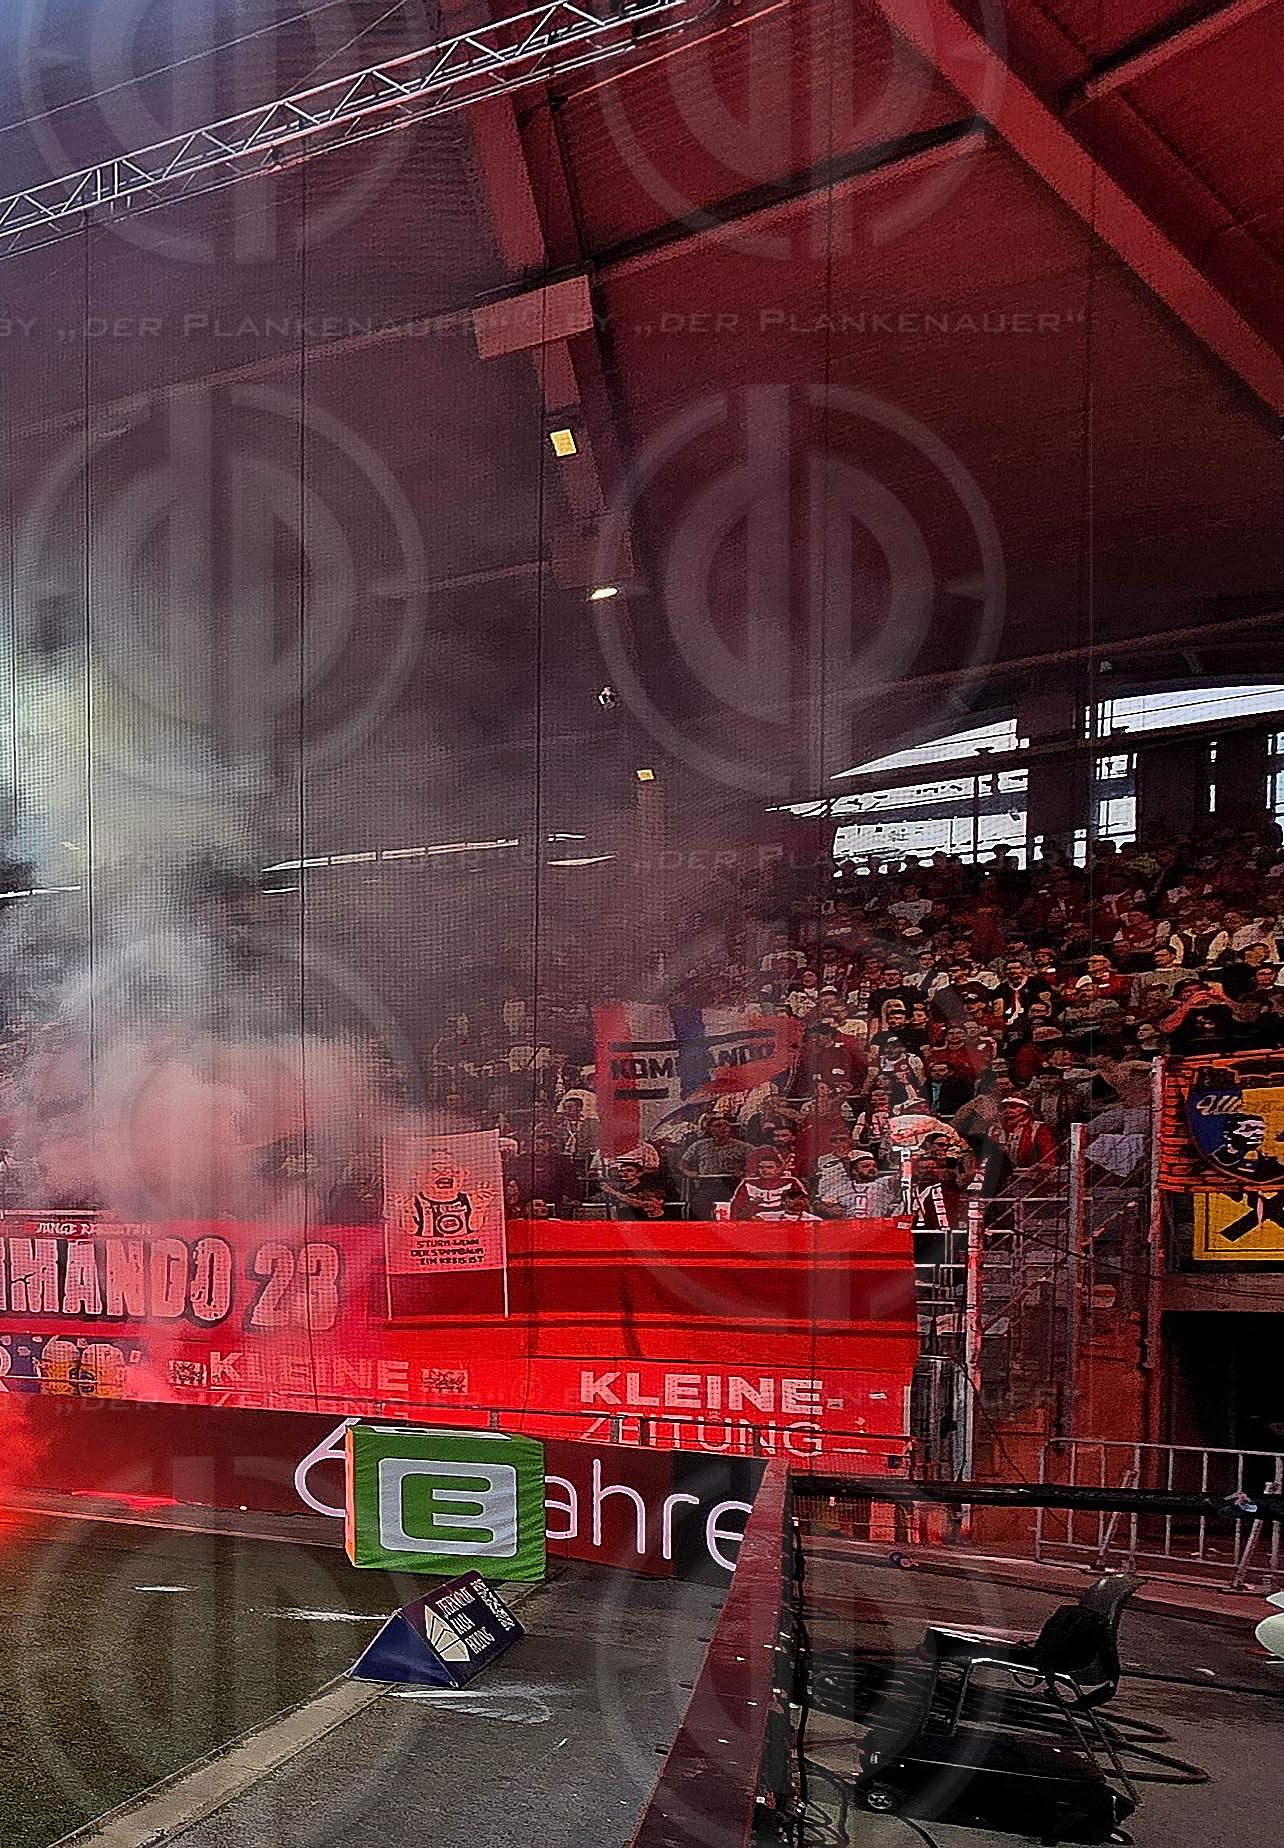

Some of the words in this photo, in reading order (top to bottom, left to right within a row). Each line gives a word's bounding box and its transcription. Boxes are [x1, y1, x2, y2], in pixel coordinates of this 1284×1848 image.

[250, 1240, 340, 1331] 23
[580, 1370, 824, 1415] KLEINE
[581, 1410, 824, 1458] ZEITUNG
[545, 1458, 753, 1571] ahre
